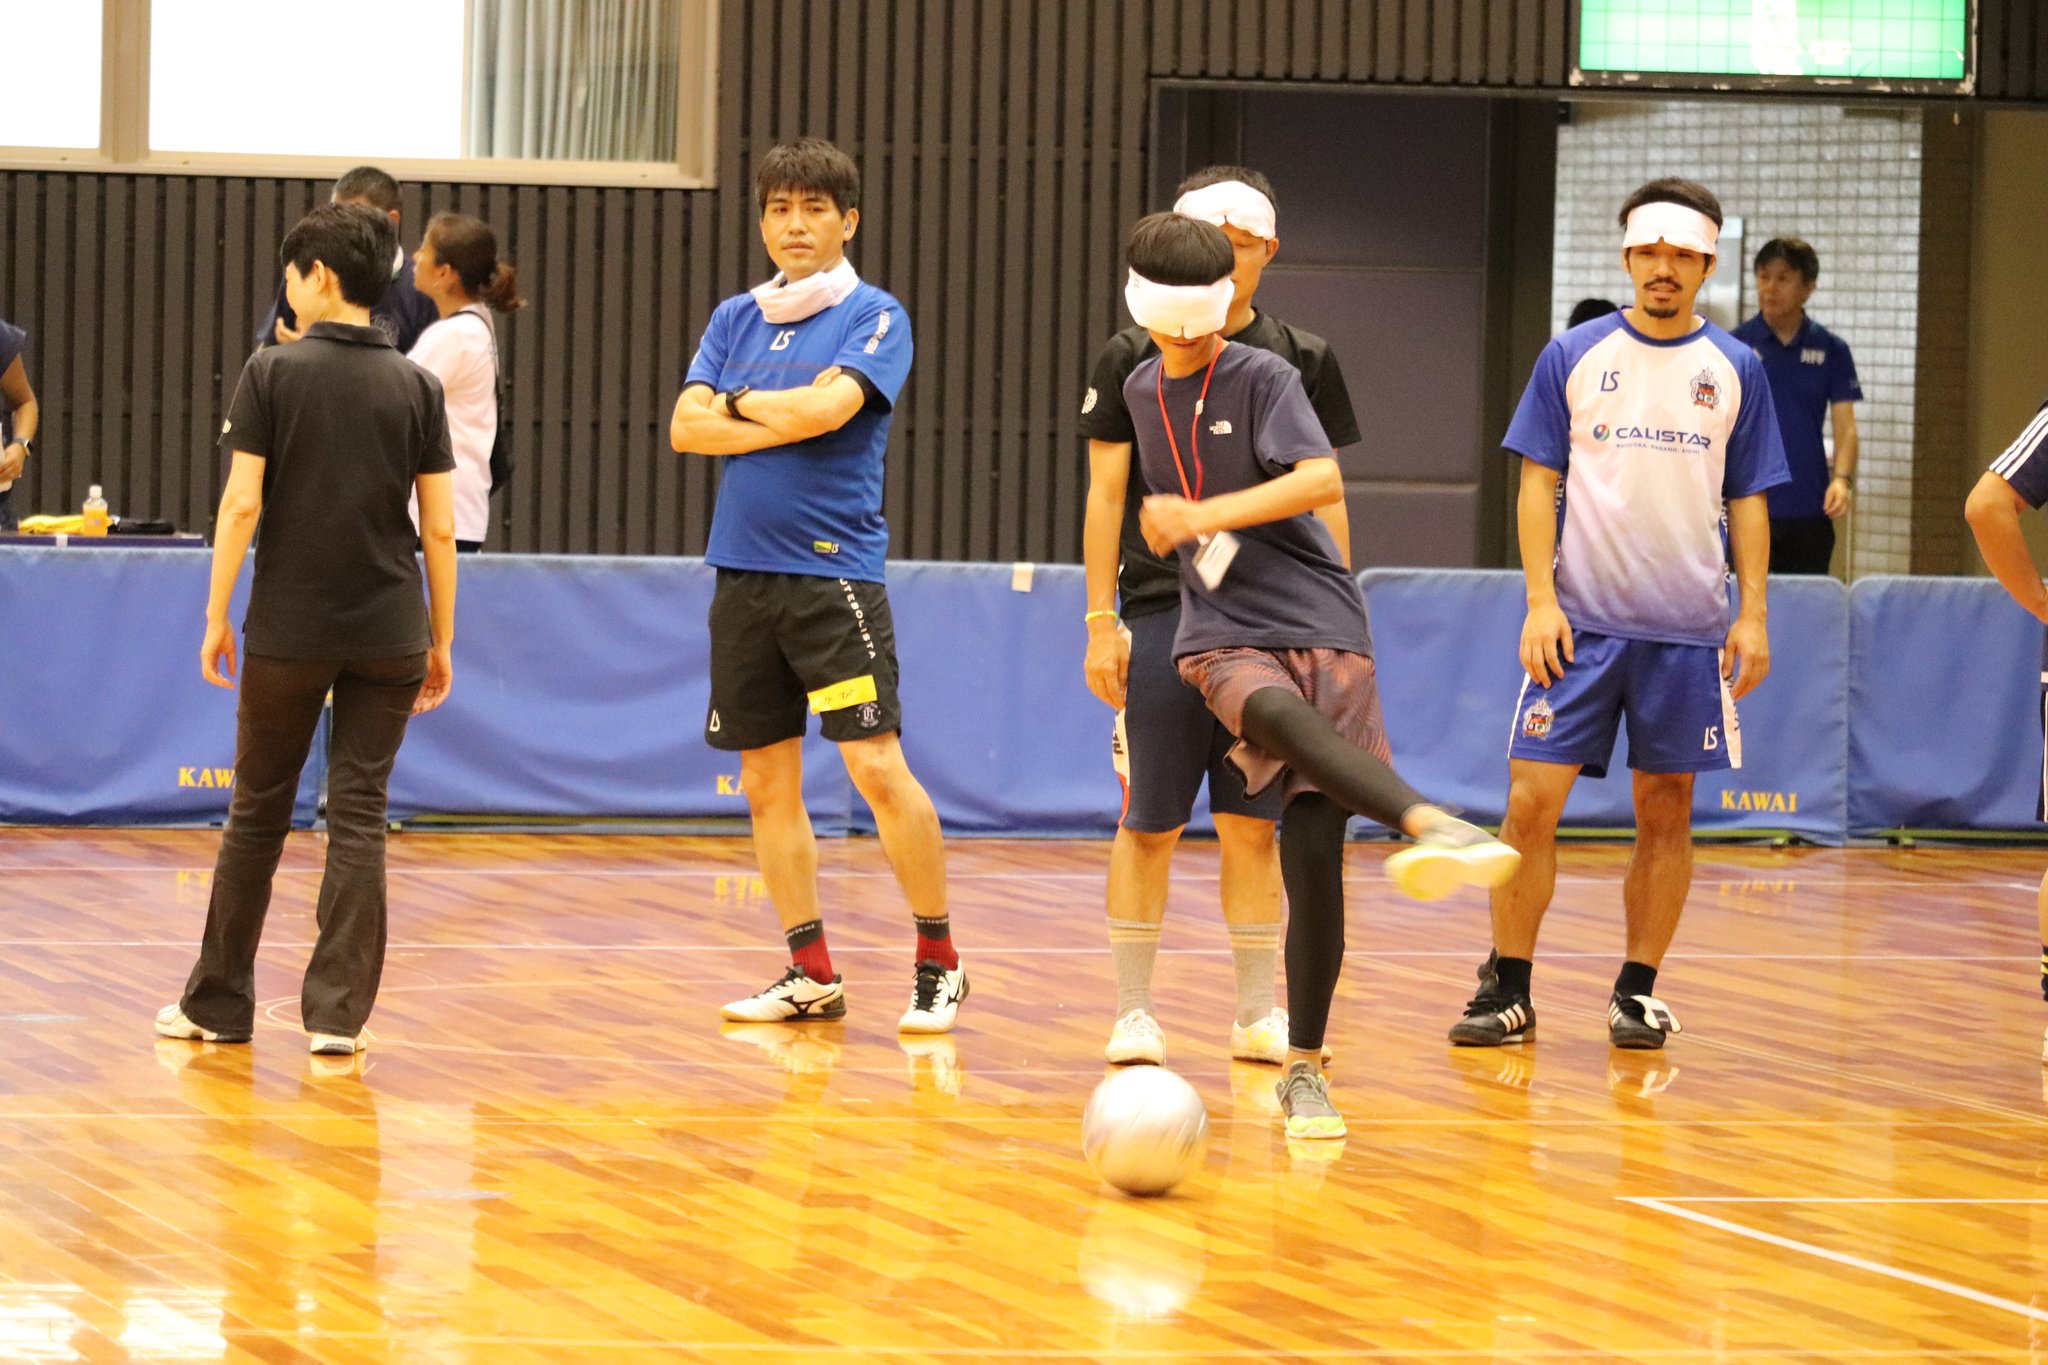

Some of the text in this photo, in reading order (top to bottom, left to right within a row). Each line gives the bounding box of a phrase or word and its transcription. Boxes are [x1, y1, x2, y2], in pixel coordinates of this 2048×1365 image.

[770, 330, 795, 351] LS
[1600, 371, 1620, 391] LS
[1616, 426, 1711, 449] CALISTAR
[1703, 726, 1718, 750] LS
[178, 767, 237, 788] KAW
[1721, 789, 1798, 813] KAWAI
